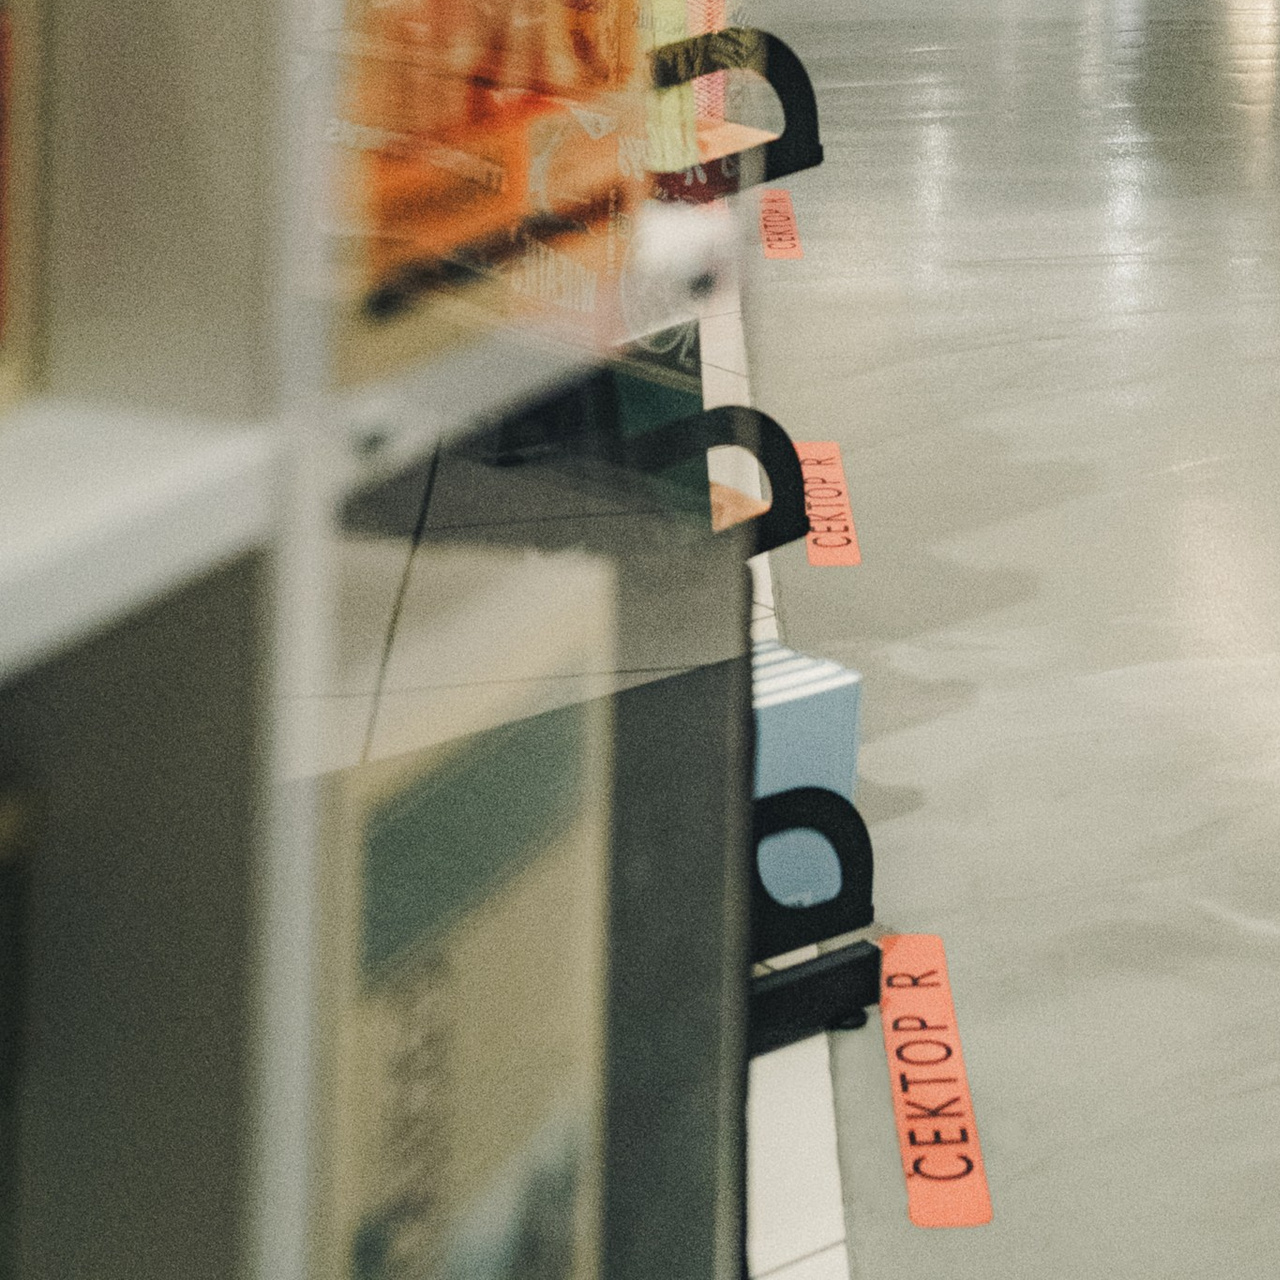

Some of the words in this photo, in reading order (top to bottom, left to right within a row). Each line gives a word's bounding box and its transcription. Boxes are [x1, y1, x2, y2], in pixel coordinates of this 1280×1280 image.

[804, 476, 851, 547] СЕКТОР
[885, 969, 940, 989] R
[891, 1015, 974, 1181] СЕКТОР
